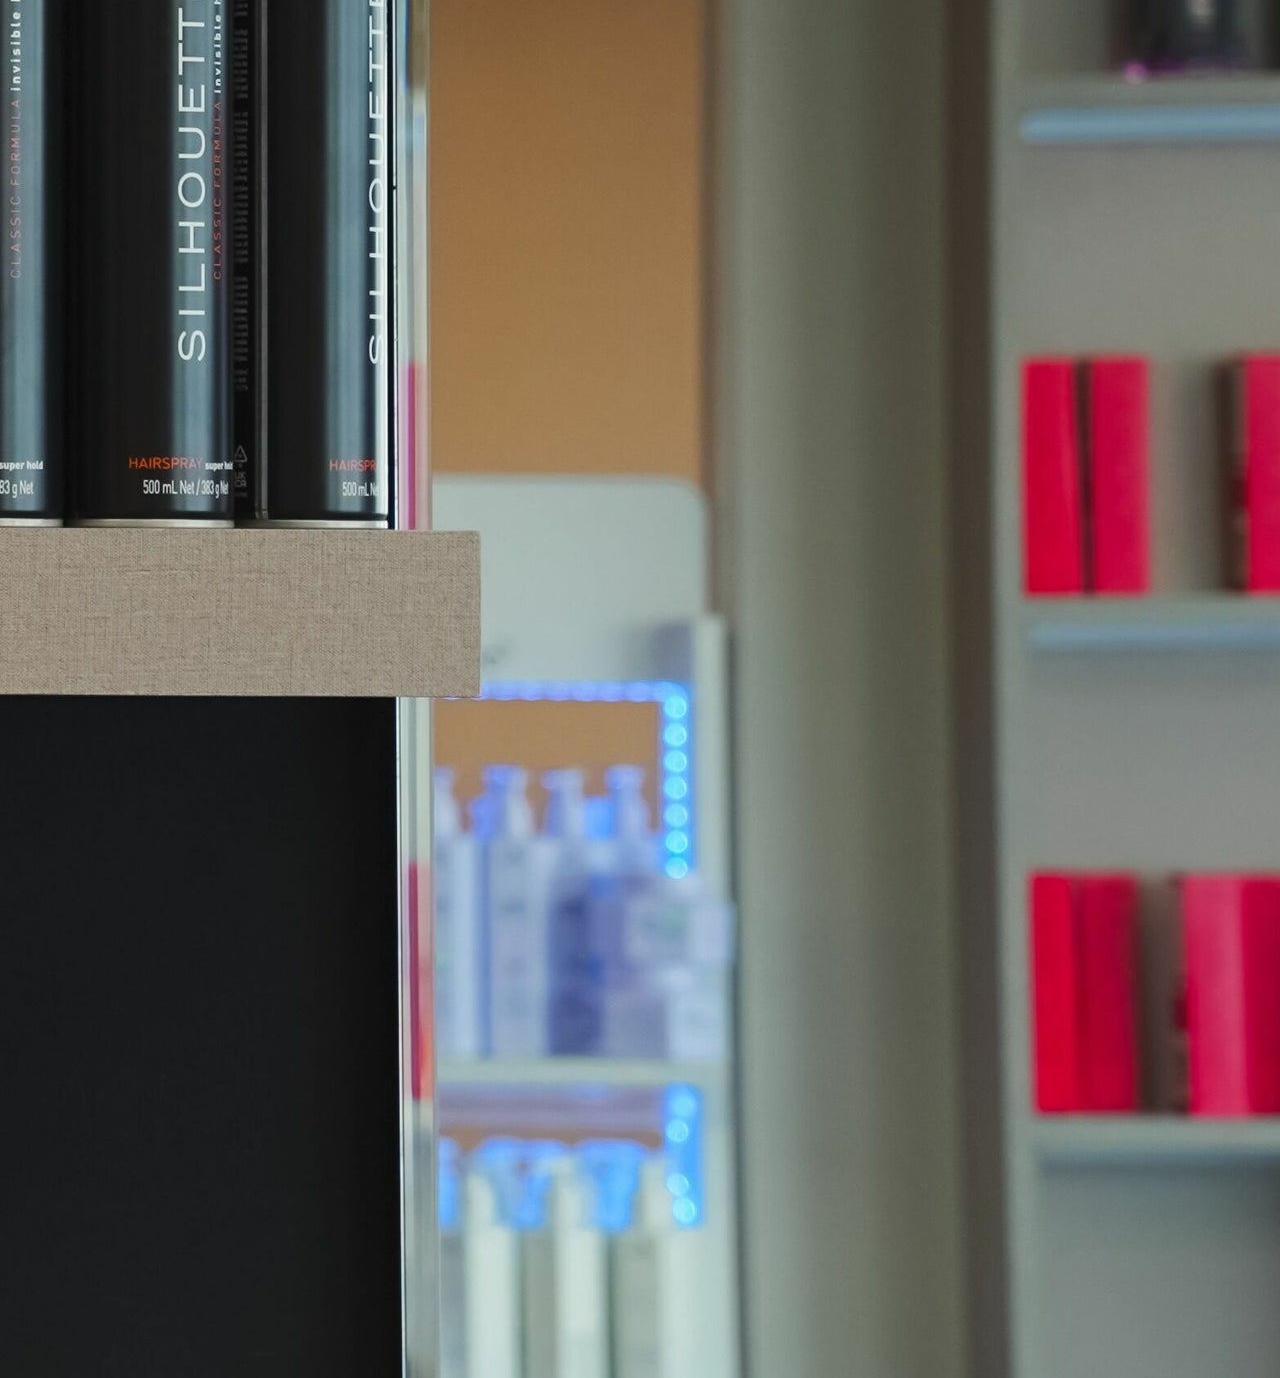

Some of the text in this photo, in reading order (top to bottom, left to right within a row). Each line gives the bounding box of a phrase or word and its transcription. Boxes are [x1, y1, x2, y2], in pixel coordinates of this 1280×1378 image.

[9, 12, 20, 91] invisible
[209, 13, 224, 92] invisible
[10, 100, 19, 185] FORMULA
[9, 197, 20, 278] CLASSIC
[26, 461, 43, 469] hold
[129, 457, 202, 469] HAIRSPRAY
[330, 459, 377, 471] HAIRSPR
[12, 484, 17, 498] g
[20, 480, 33, 494] Net
[342, 481, 369, 497] 500 mL
